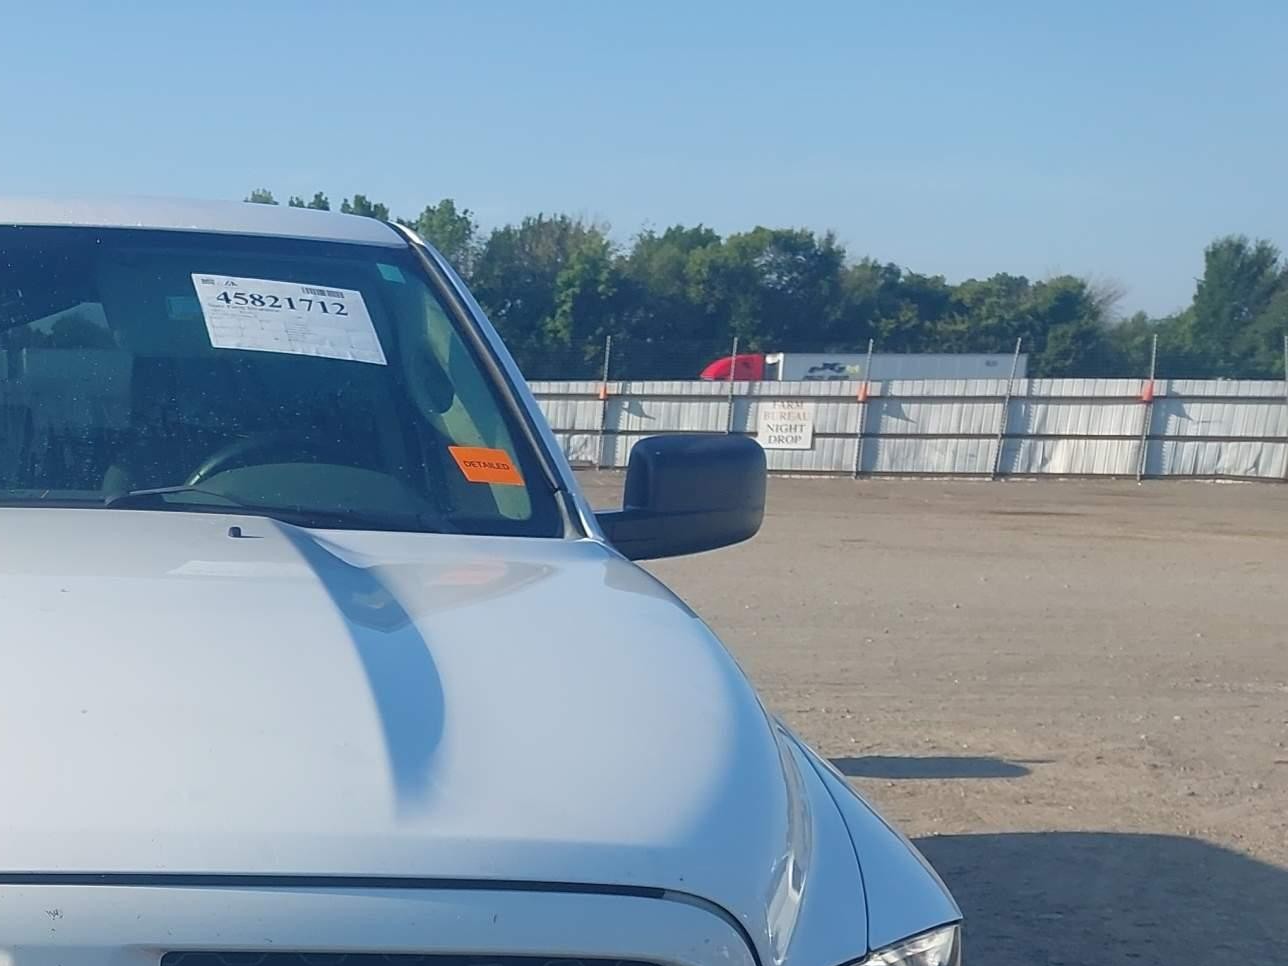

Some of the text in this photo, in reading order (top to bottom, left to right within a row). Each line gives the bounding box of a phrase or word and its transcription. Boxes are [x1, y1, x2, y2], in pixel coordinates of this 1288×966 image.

[216, 290, 349, 317] 45821712
[773, 399, 804, 410] FARM
[767, 423, 806, 434] NIGHT
[768, 435, 802, 445] DROP
[463, 460, 510, 471] DETAILED
